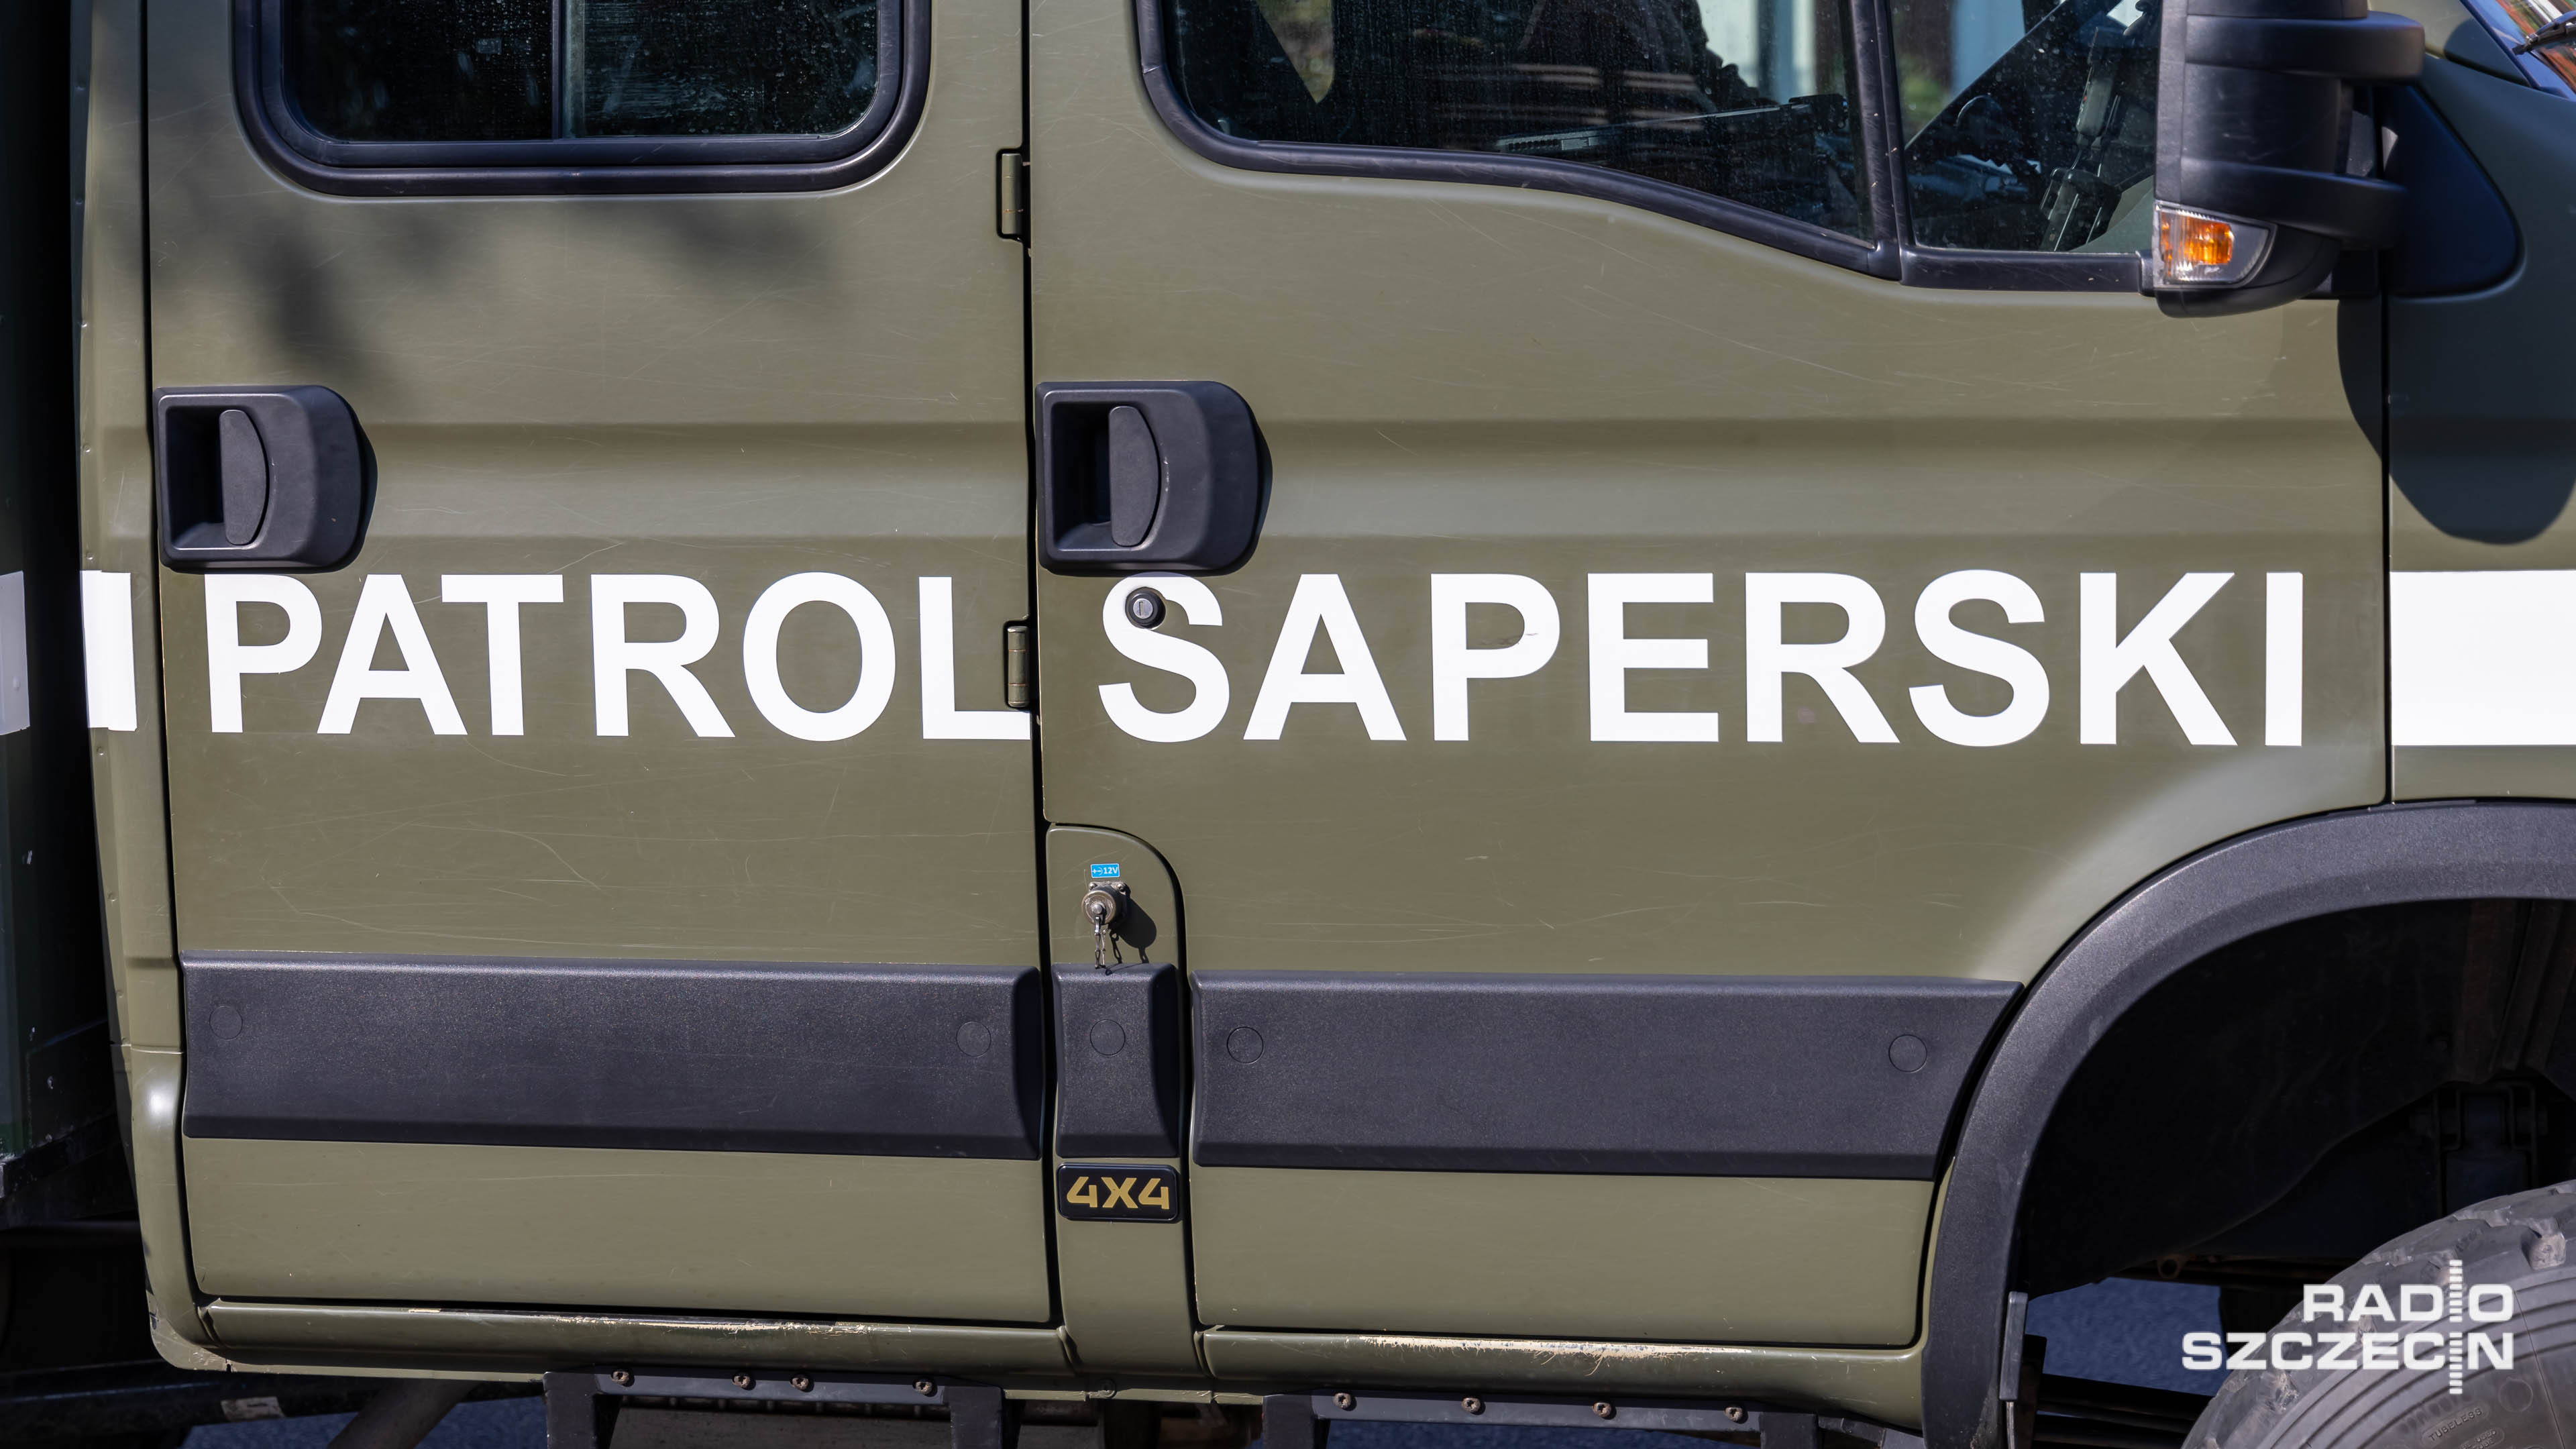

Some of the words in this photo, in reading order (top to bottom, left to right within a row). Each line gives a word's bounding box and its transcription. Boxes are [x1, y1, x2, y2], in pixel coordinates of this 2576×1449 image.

[204, 573, 1032, 741] PATROL
[1098, 571, 2304, 747] SAPERSKI
[1103, 867, 1118, 875] 12V
[1066, 1176, 1170, 1210] 4X4
[2428, 1407, 2482, 1441] TUBELESS
